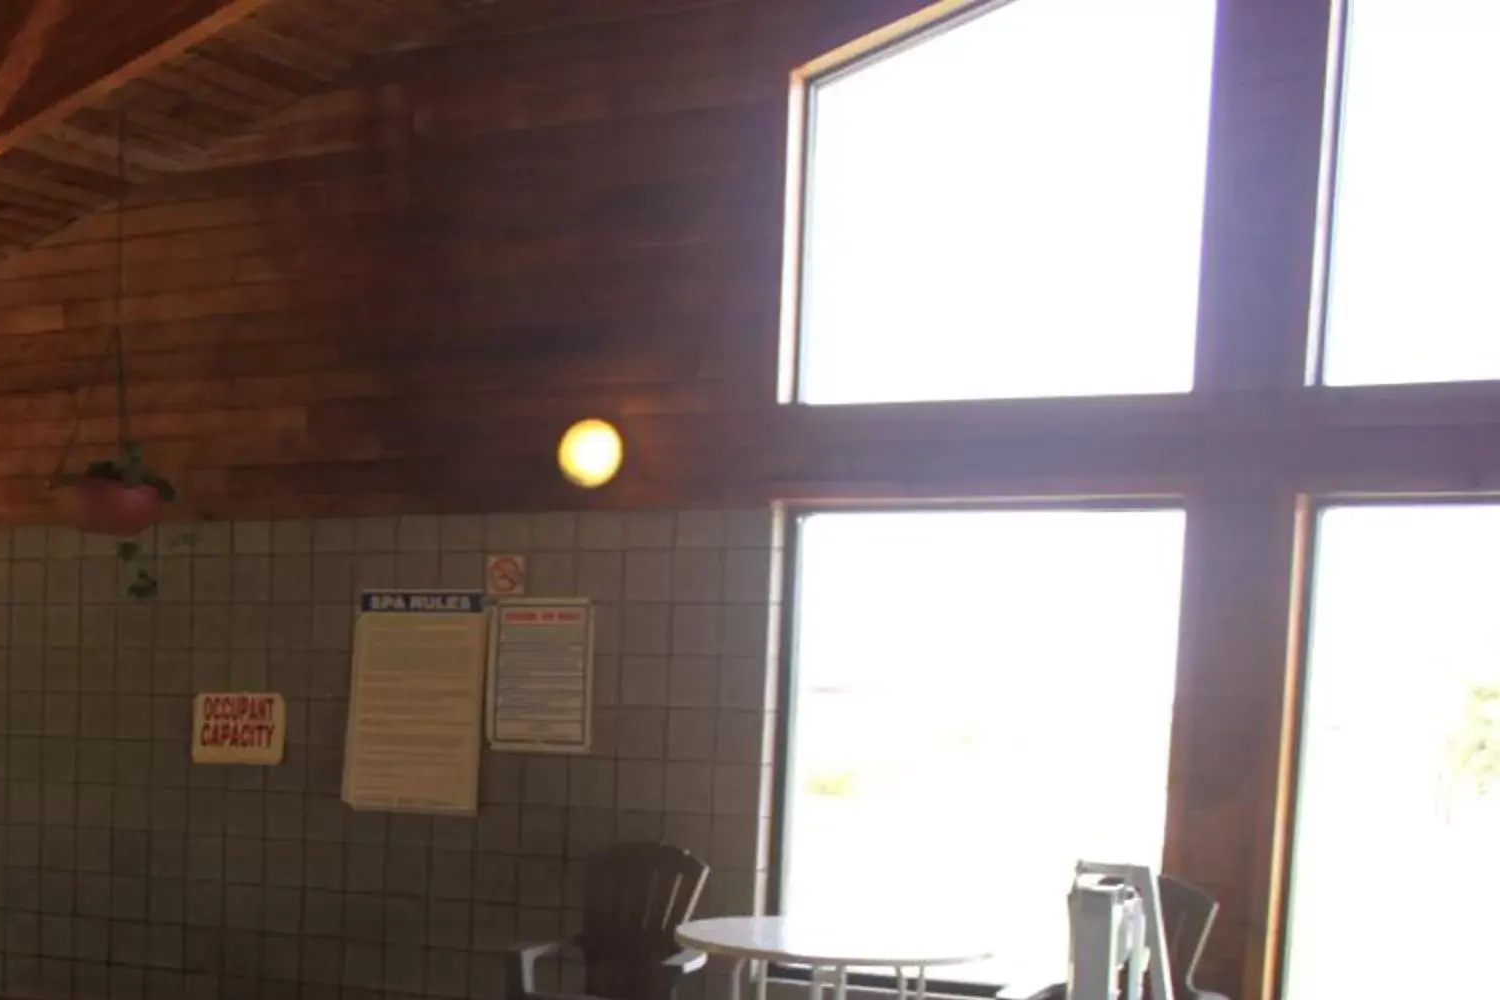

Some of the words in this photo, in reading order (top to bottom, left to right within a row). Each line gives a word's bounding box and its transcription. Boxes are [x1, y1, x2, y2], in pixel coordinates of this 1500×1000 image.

[372, 594, 405, 610] SPA
[409, 594, 471, 611] RULES
[203, 696, 274, 721] OCCUPANT
[200, 723, 275, 748] CAPACITY
